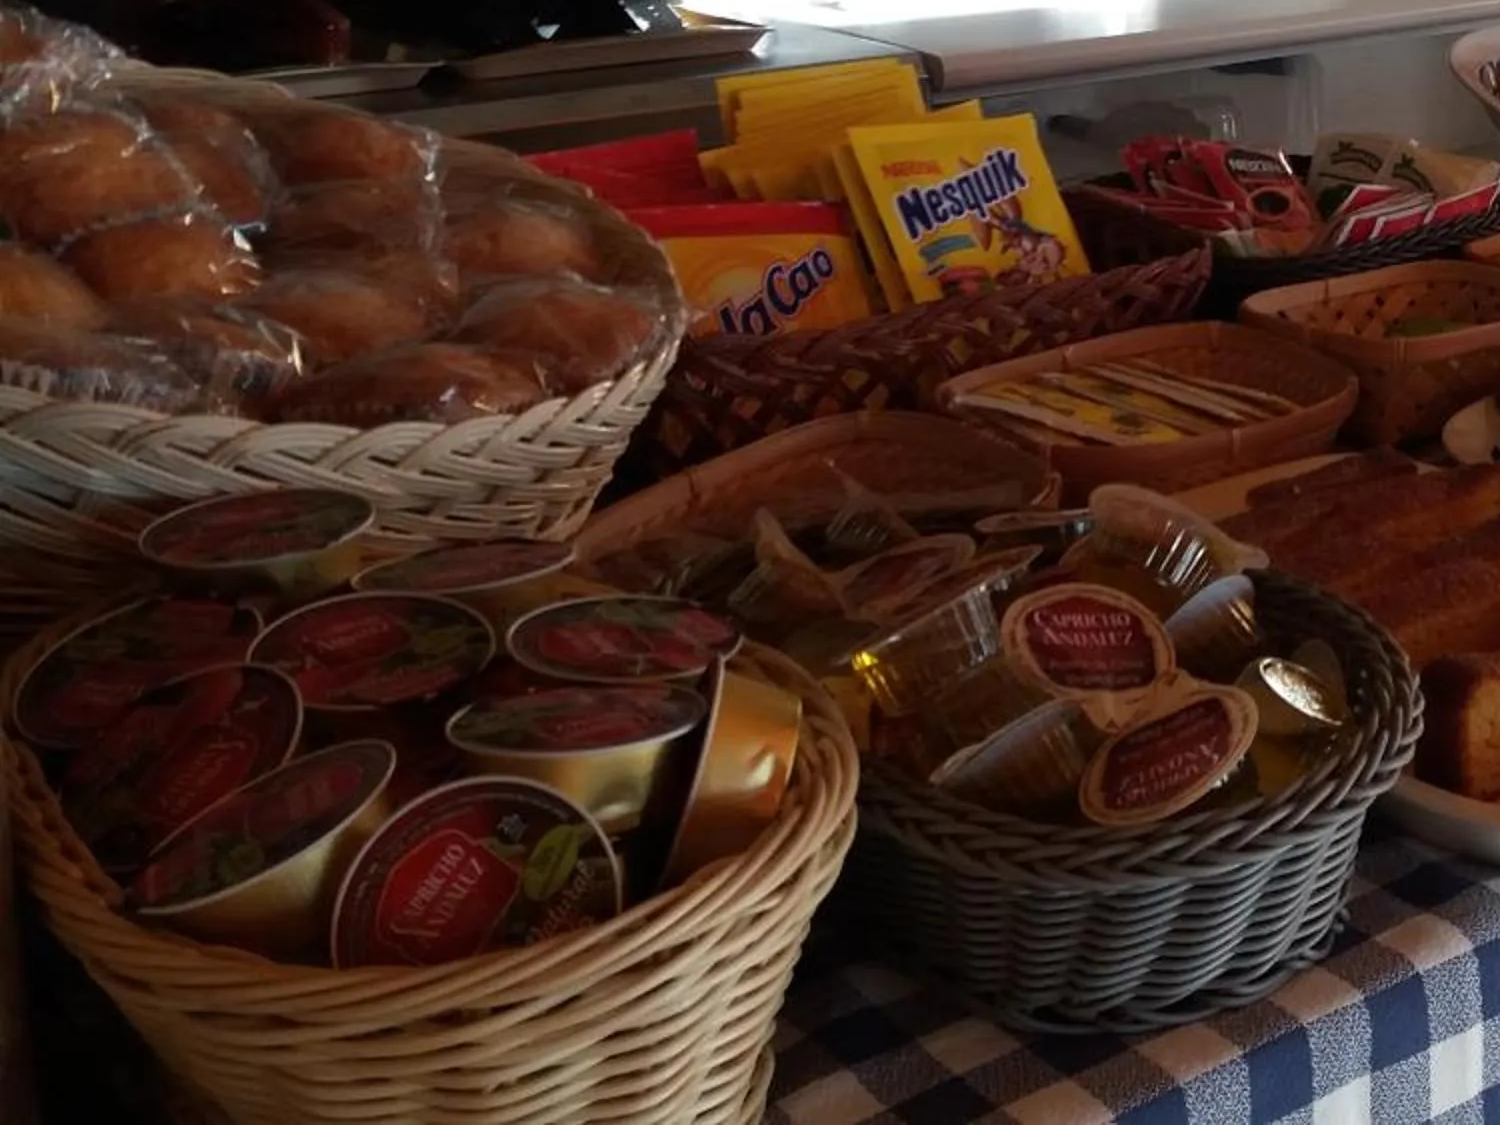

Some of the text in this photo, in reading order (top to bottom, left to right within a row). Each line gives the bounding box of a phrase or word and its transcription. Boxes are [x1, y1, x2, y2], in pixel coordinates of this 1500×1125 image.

[895, 149, 1027, 241] Nesquik
[1033, 611, 1132, 629] CAPRICHO
[1044, 628, 1133, 648] ANDALUZ
[389, 842, 467, 935] CAPRICHO
